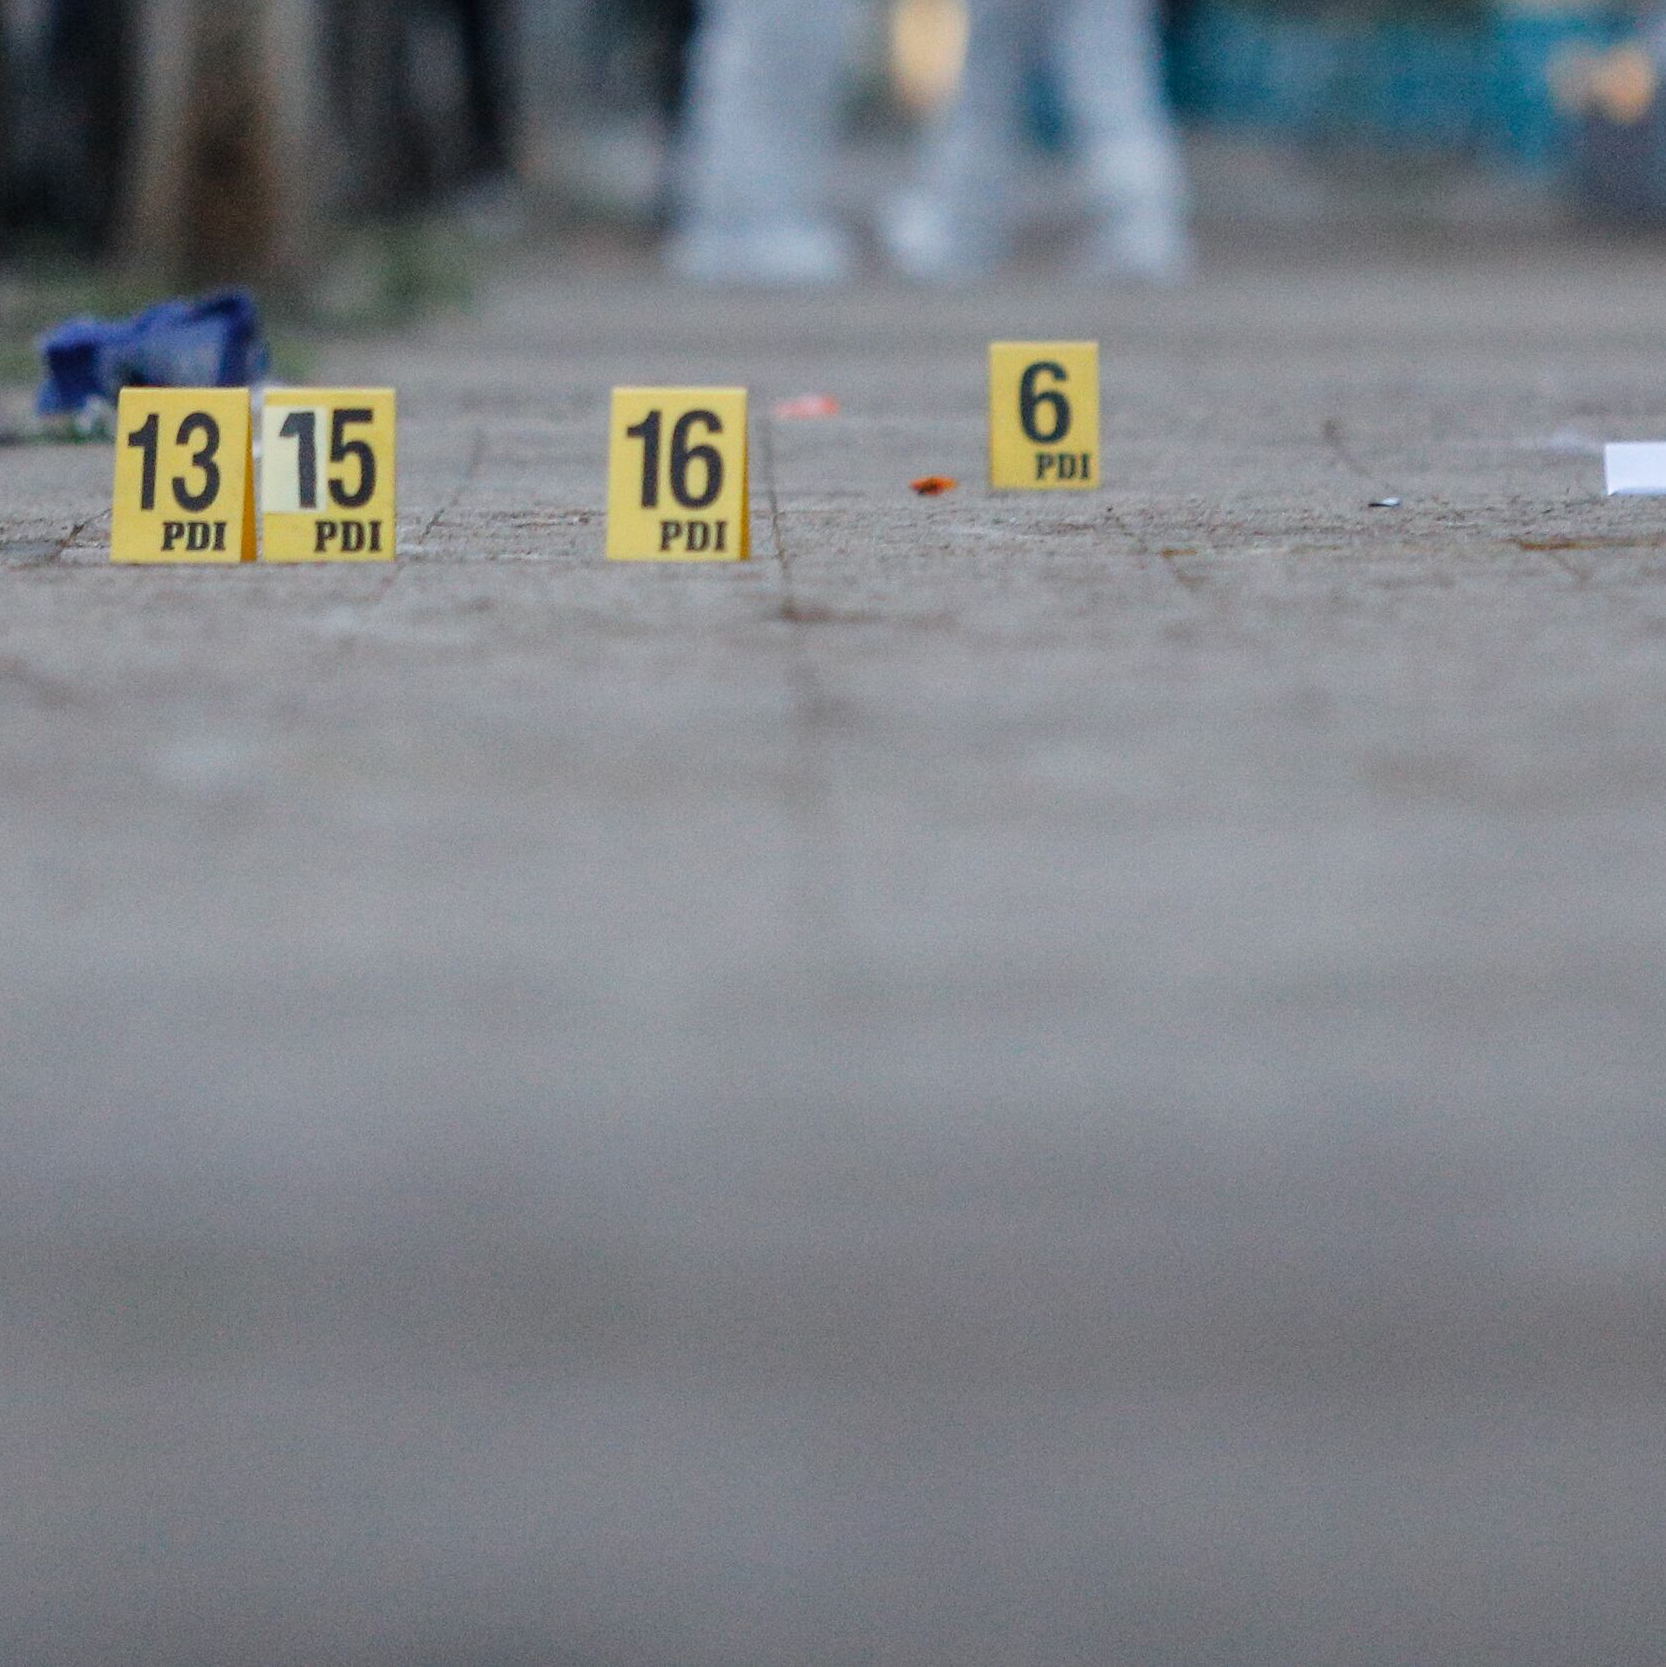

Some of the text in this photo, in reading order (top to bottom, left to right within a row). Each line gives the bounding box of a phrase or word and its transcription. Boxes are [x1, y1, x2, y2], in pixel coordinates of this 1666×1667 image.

[1020, 361, 1072, 444] 6
[128, 412, 221, 513] 13
[279, 409, 376, 509] 15
[627, 410, 724, 510] 16
[1036, 452, 1091, 480] PDI
[161, 521, 228, 551] PDI
[314, 521, 383, 552] PDI
[659, 521, 727, 552] PDI
